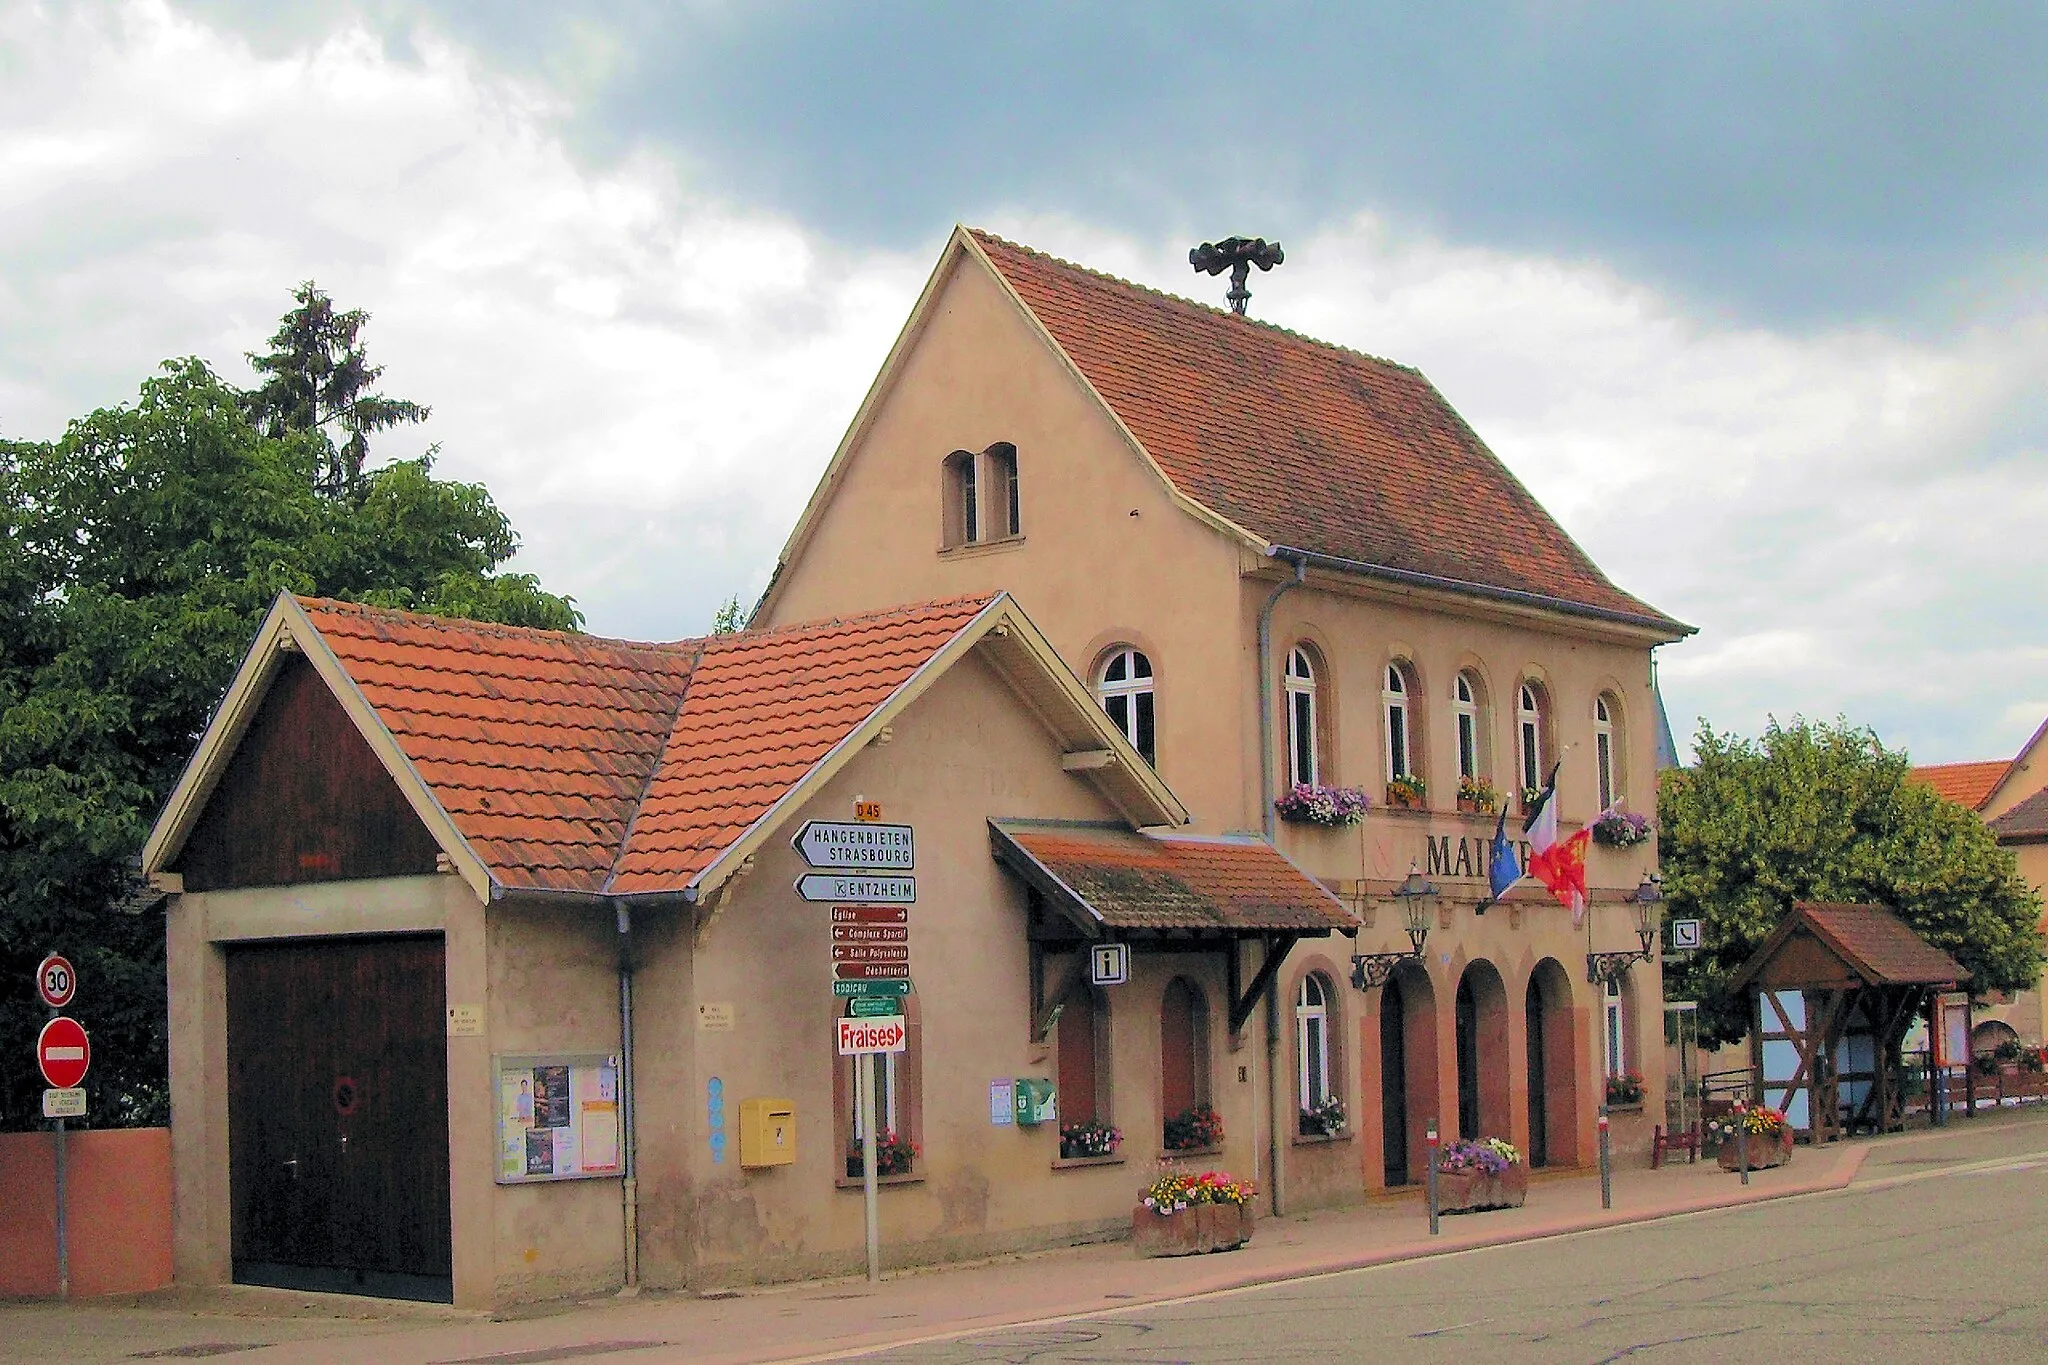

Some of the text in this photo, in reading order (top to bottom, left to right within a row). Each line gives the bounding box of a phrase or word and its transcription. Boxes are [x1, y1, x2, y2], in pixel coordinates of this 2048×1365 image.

[857, 804, 880, 818] D 45
[814, 829, 909, 846] HANGENBIETEN
[829, 847, 910, 862] STRASBOURG
[1426, 836, 1535, 878] MAIE
[47, 971, 67, 992] 30
